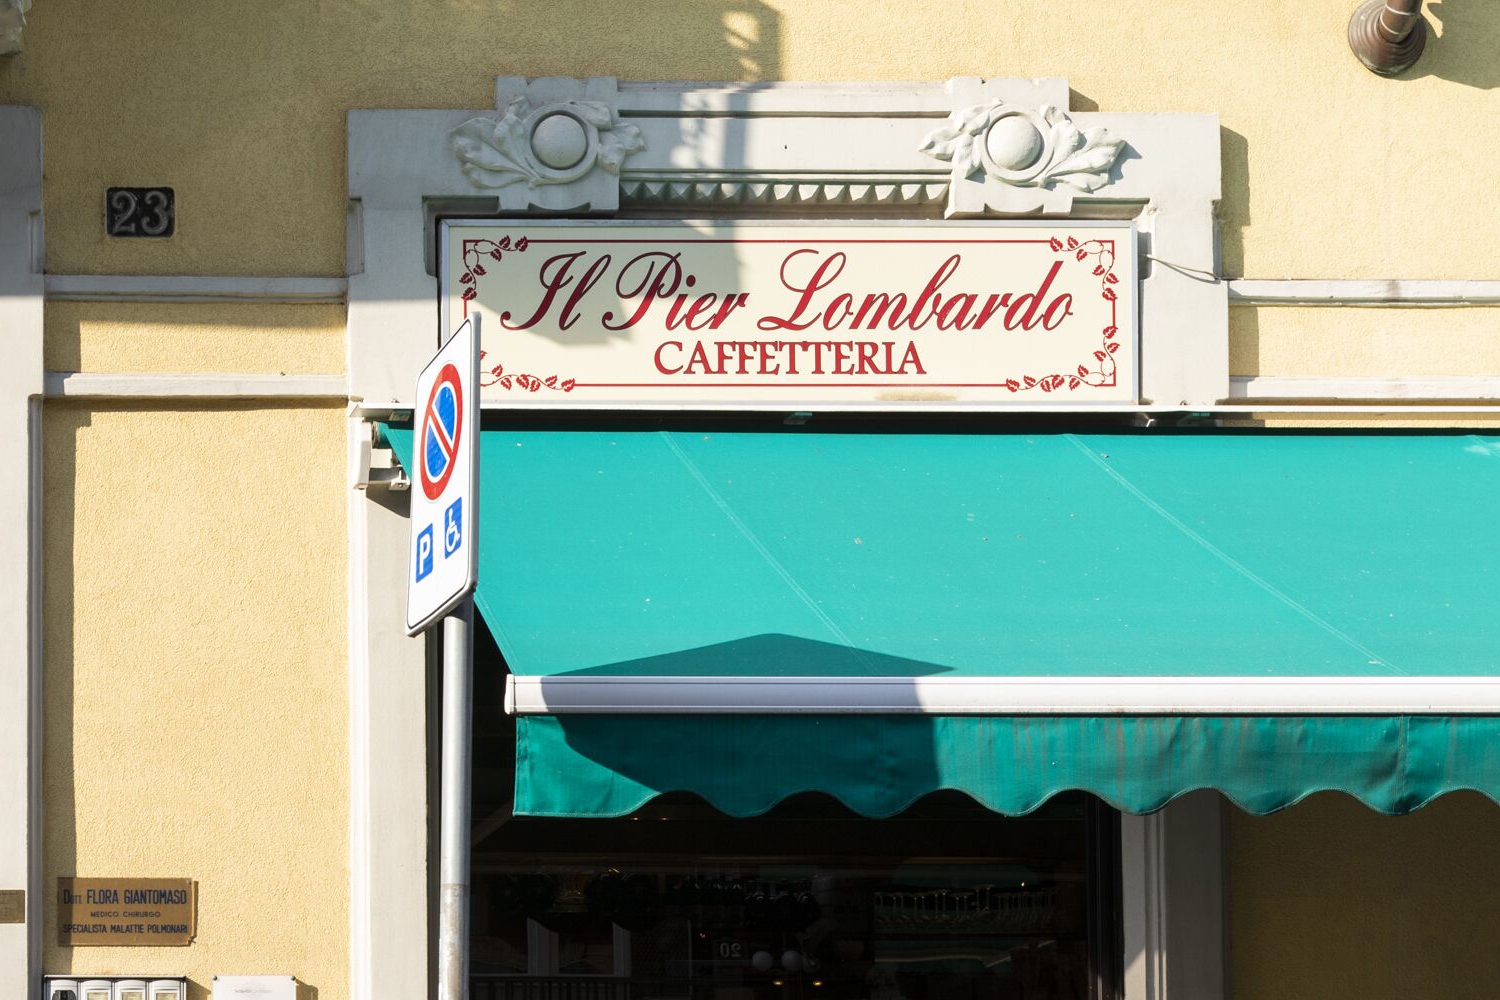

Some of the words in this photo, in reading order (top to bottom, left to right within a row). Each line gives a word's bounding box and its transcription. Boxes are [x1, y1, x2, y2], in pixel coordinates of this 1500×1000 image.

[111, 190, 169, 235] 23
[499, 248, 611, 332] Il
[602, 250, 750, 332] Pier
[756, 247, 1074, 332] Lombardo
[653, 340, 928, 376] CAFFETTERIA
[86, 889, 119, 905] FLORA
[123, 889, 187, 905] GIANTOMASO
[63, 924, 107, 933] SPECIALISTA
[110, 924, 144, 933] MALATTIE
[147, 924, 188, 933] POLMONARI
